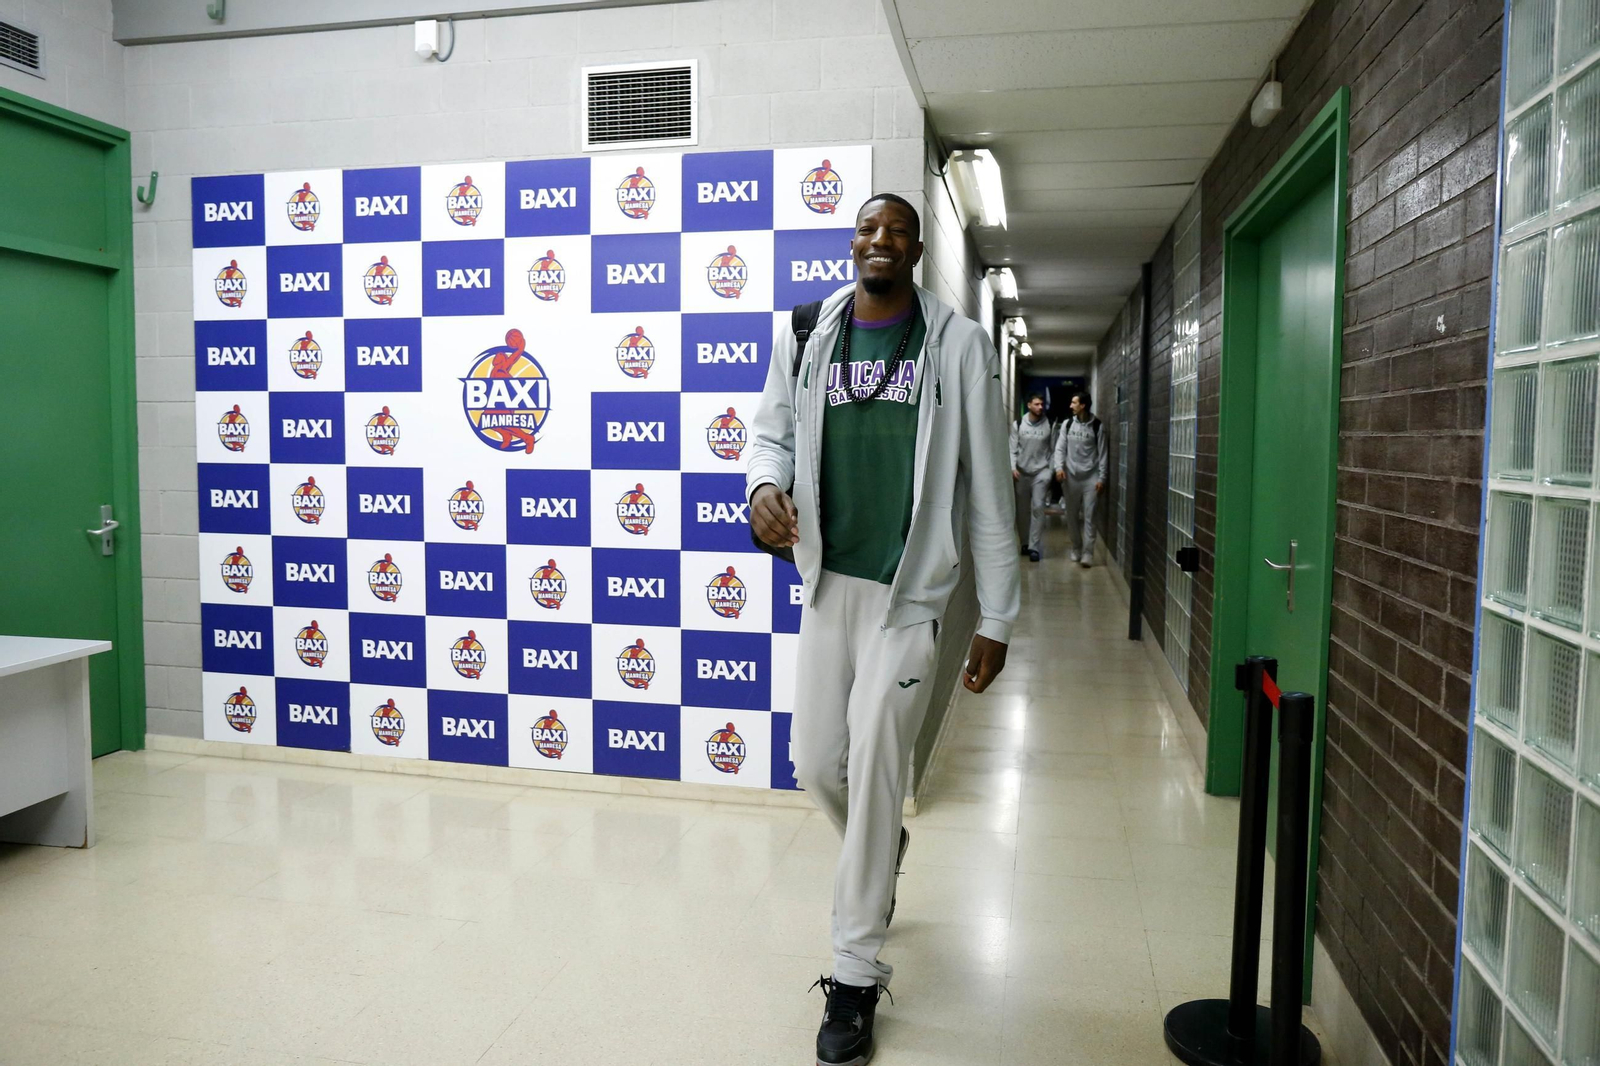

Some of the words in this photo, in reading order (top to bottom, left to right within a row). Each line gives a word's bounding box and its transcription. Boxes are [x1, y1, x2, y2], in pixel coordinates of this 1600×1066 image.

[619, 188, 655, 202] BAXI
[697, 180, 758, 203] BAXI
[803, 181, 842, 196] BAXI
[355, 195, 407, 216] BAXI
[449, 196, 481, 209] BAXI
[520, 187, 576, 209] BAXI
[204, 201, 252, 221] BAXI
[289, 201, 320, 215] BAXI
[530, 271, 565, 284] BAXI
[606, 263, 665, 284] BAXI
[710, 267, 747, 280] BAXI
[791, 258, 854, 281] BAXI
[216, 279, 246, 291] BAXI
[280, 272, 329, 292] BAXI
[366, 275, 398, 288] BAXI
[436, 268, 490, 289] BAXI
[207, 347, 255, 365] BAXI
[291, 350, 322, 363] BAXI
[357, 346, 408, 365] BAXI
[618, 347, 654, 360] BAXI
[697, 343, 757, 363] BAXI
[466, 380, 548, 409] BAXI
[219, 423, 249, 435] BAXI
[283, 419, 332, 438] BAXI
[482, 415, 535, 429] MANRESA
[368, 426, 400, 439] BAXI
[607, 422, 664, 441] BAXI
[709, 429, 746, 442] BAXI
[211, 490, 258, 508] BAXI
[294, 496, 325, 508] BAXI
[360, 494, 410, 513] BAXI
[450, 500, 483, 513] BAXI
[521, 498, 576, 518] BAXI
[618, 504, 654, 517] BAXI
[697, 502, 749, 523] BAX
[223, 565, 252, 577] BAXI
[286, 563, 334, 582] BAXI
[369, 572, 402, 585] BAXI
[440, 571, 493, 591] BAXI
[531, 579, 566, 592] BAXI
[608, 577, 664, 598] BAXI
[709, 587, 746, 600] BAXI
[214, 630, 261, 649] BAXI
[297, 638, 327, 651] BAXI
[362, 640, 412, 660] BAXI
[453, 650, 485, 662] BAXI
[523, 649, 577, 670] BAXI
[619, 659, 655, 672] BAXI
[697, 659, 755, 681] BAXI
[227, 704, 256, 716] BAXI
[289, 704, 337, 725] BAXI
[373, 717, 405, 730] BAXI
[442, 717, 494, 738] BAXI
[533, 729, 567, 742] BAXI
[608, 729, 664, 751] BAXI
[708, 742, 745, 756] BAXI
